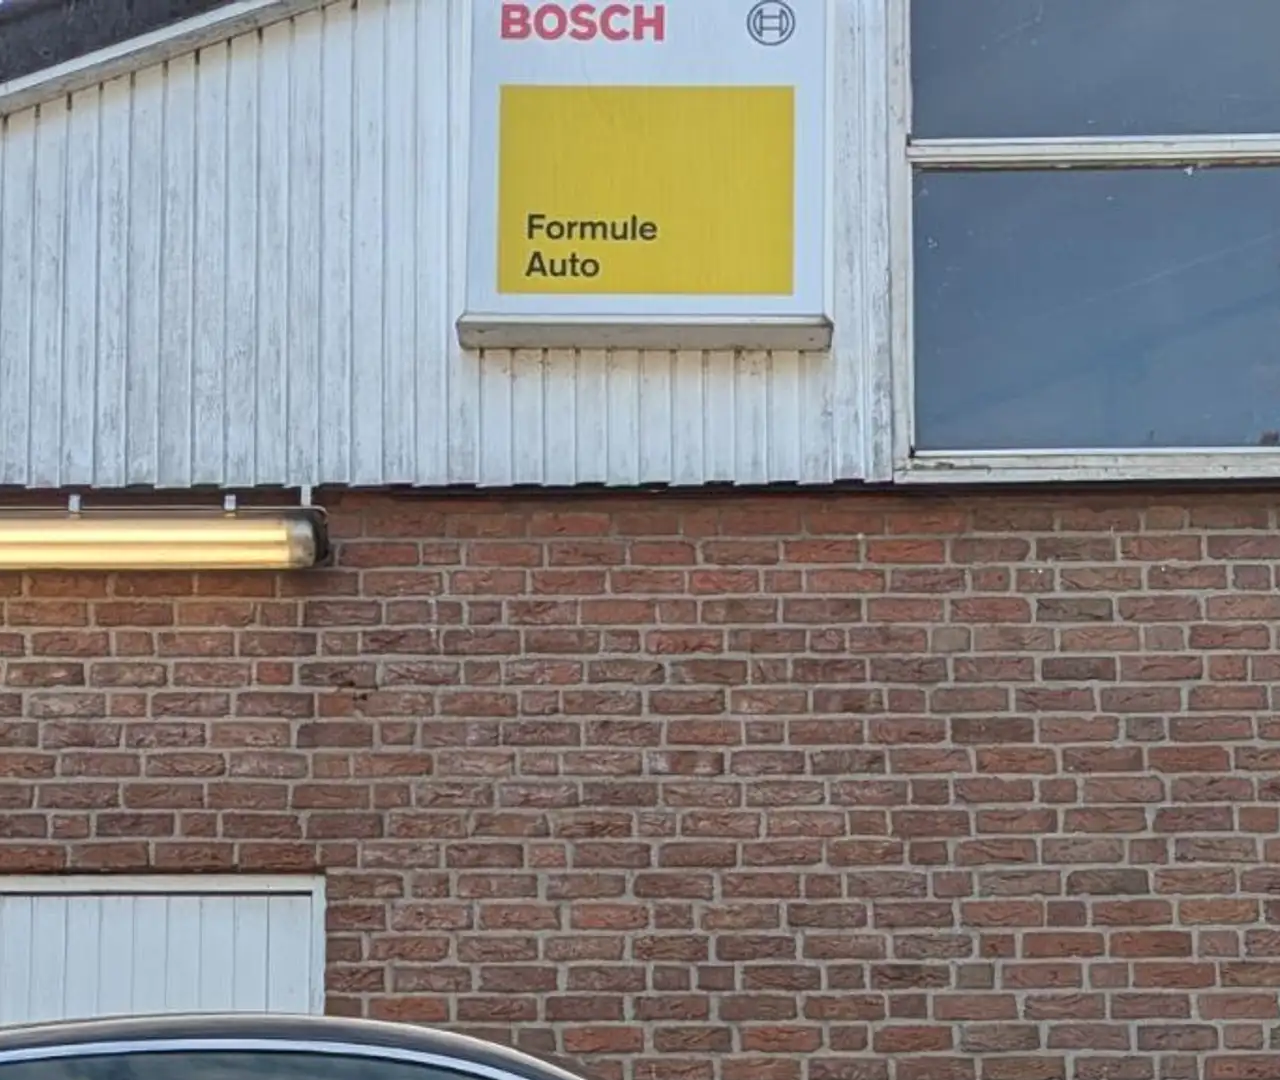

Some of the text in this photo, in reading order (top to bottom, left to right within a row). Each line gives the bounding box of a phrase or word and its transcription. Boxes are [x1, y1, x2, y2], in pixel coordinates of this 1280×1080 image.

[501, 3, 664, 41] BOSCH
[527, 214, 658, 241] Formule
[525, 250, 600, 277] Auto
